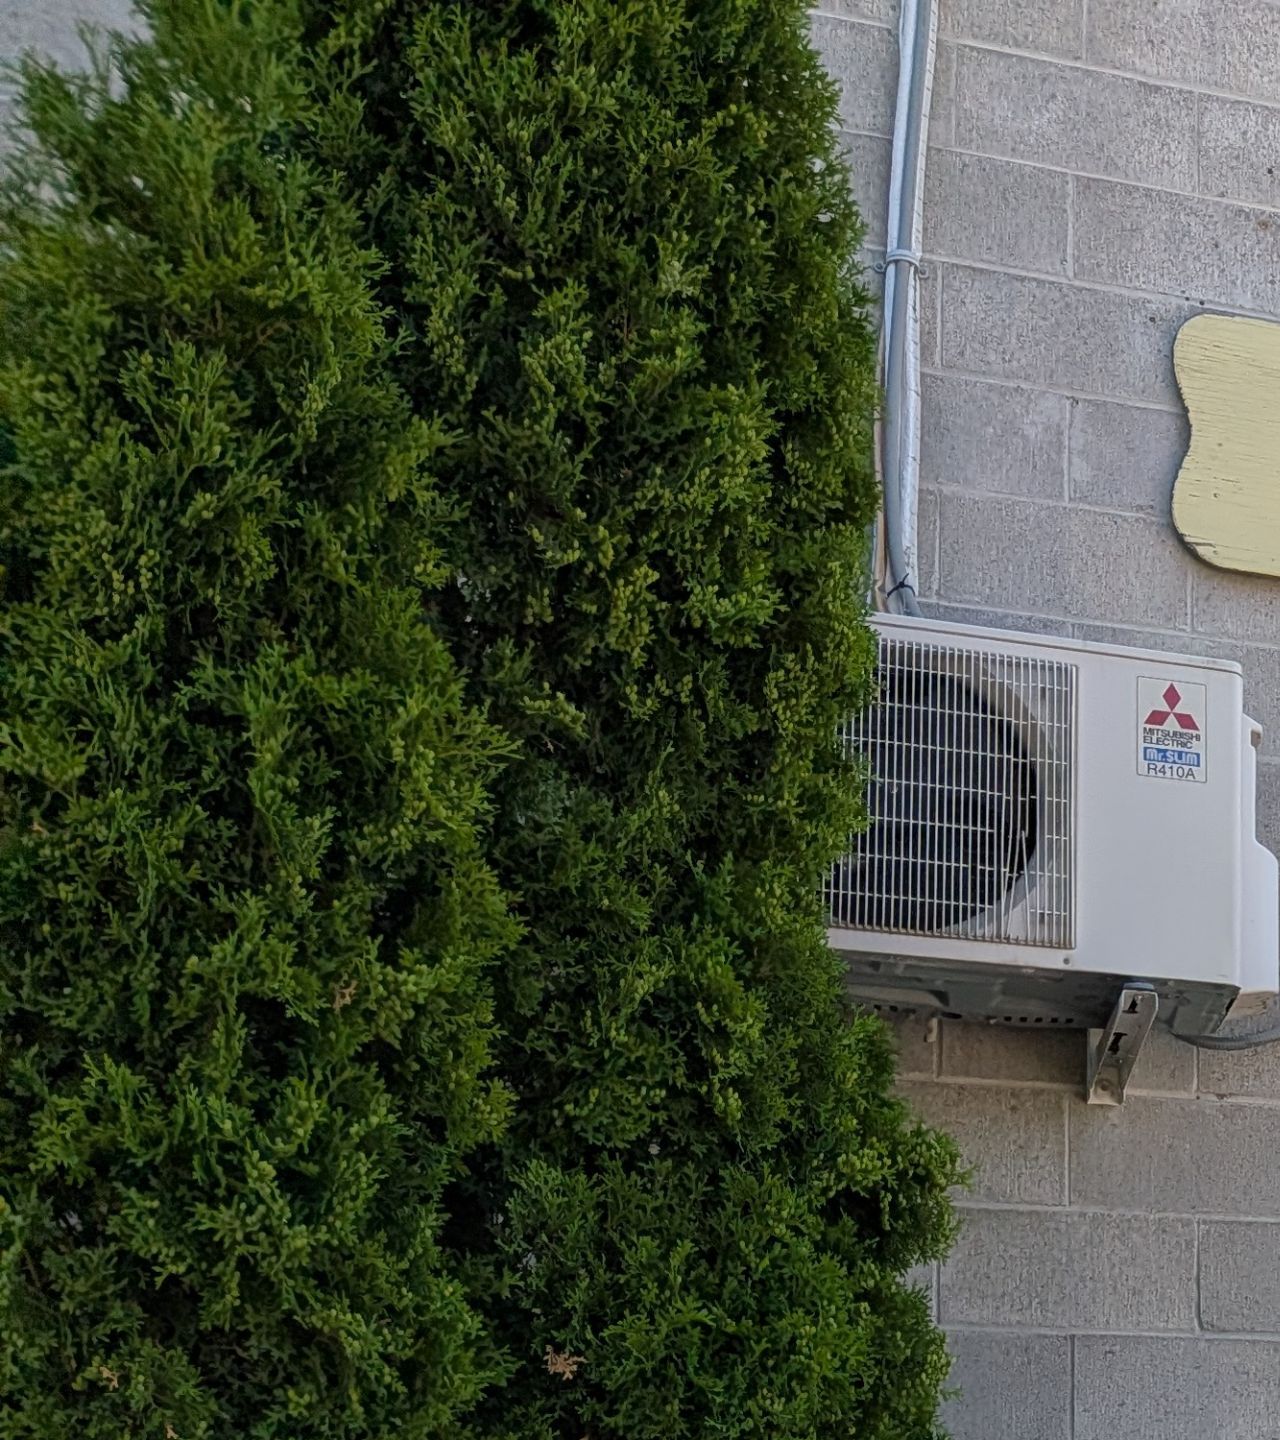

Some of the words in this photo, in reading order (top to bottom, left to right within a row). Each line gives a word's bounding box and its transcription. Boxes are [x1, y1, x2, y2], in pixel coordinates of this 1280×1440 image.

[1143, 726, 1201, 742] MITSUBISHI
[1143, 735, 1193, 750] ELECTRIC
[1147, 762, 1196, 780] R410A
